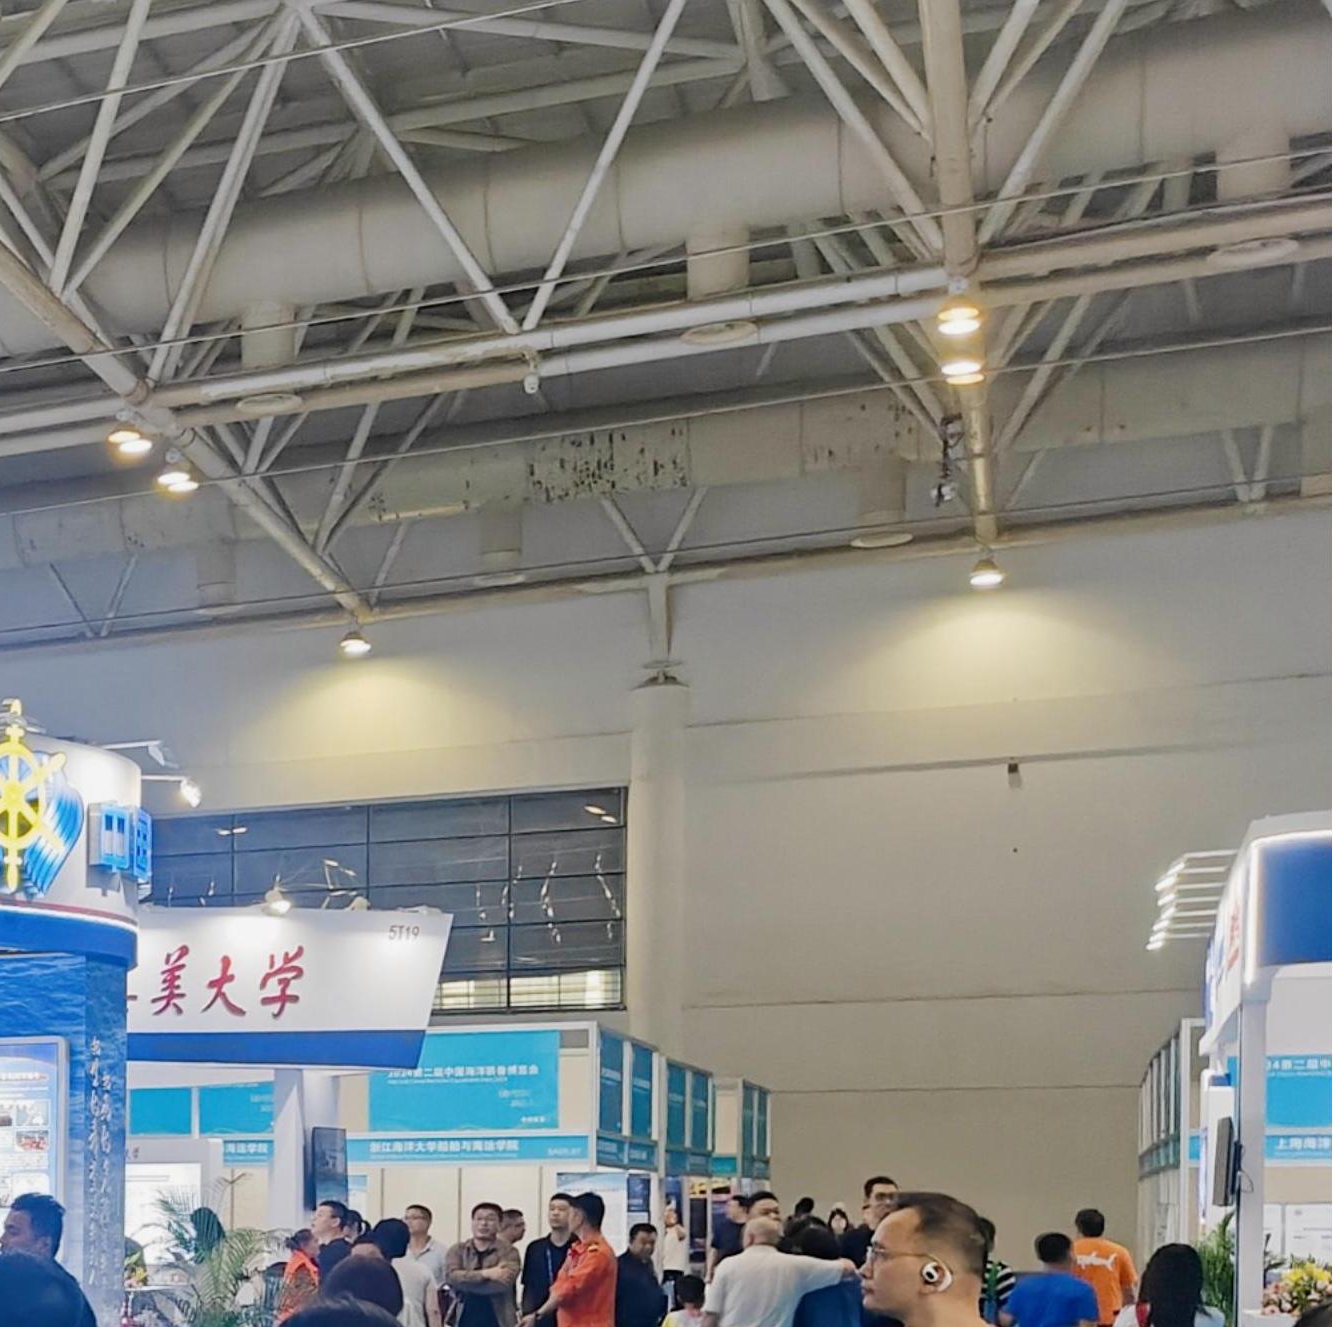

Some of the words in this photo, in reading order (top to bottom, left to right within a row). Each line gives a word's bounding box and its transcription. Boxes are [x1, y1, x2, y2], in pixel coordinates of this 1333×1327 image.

[388, 925, 420, 940] 5T19
[128, 944, 305, 1019] 美大学
